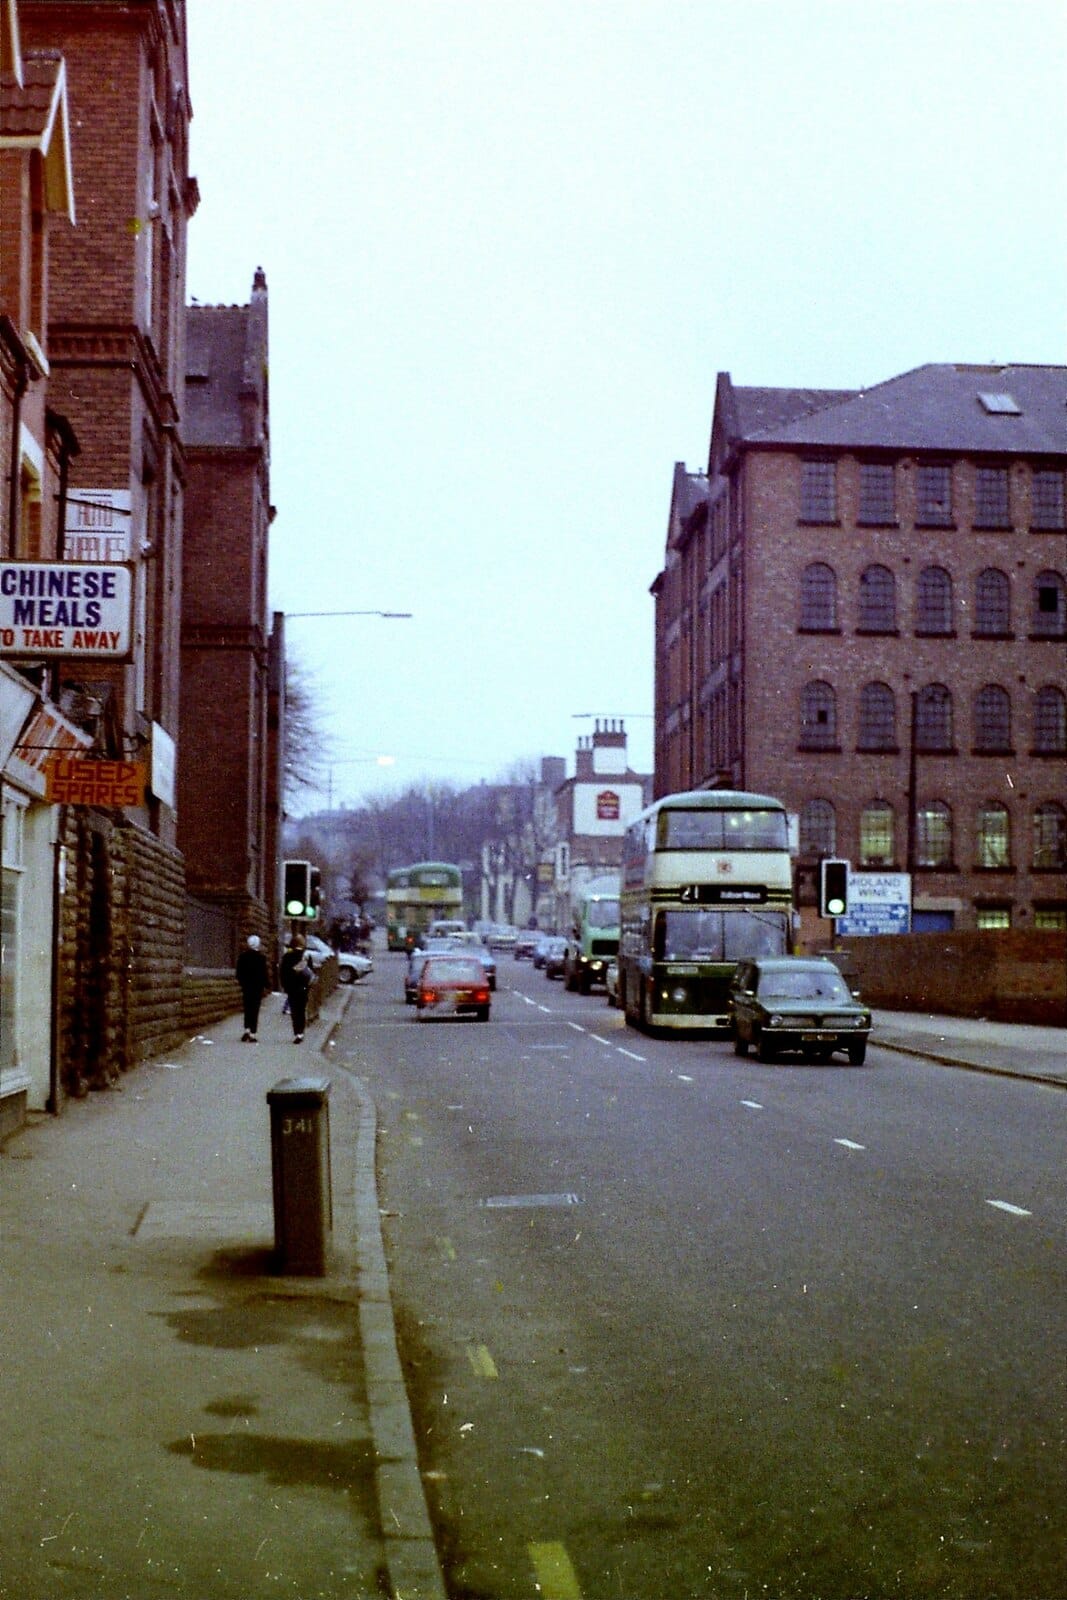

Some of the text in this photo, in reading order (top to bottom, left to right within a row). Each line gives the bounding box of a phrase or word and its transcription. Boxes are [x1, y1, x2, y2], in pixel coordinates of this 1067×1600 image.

[1, 569, 116, 599] CHINESE
[13, 600, 102, 628] MEALS
[23, 630, 64, 648] TAKE
[73, 632, 121, 649] AWAY
[54, 759, 137, 783] USED
[51, 782, 138, 806] SPARES
